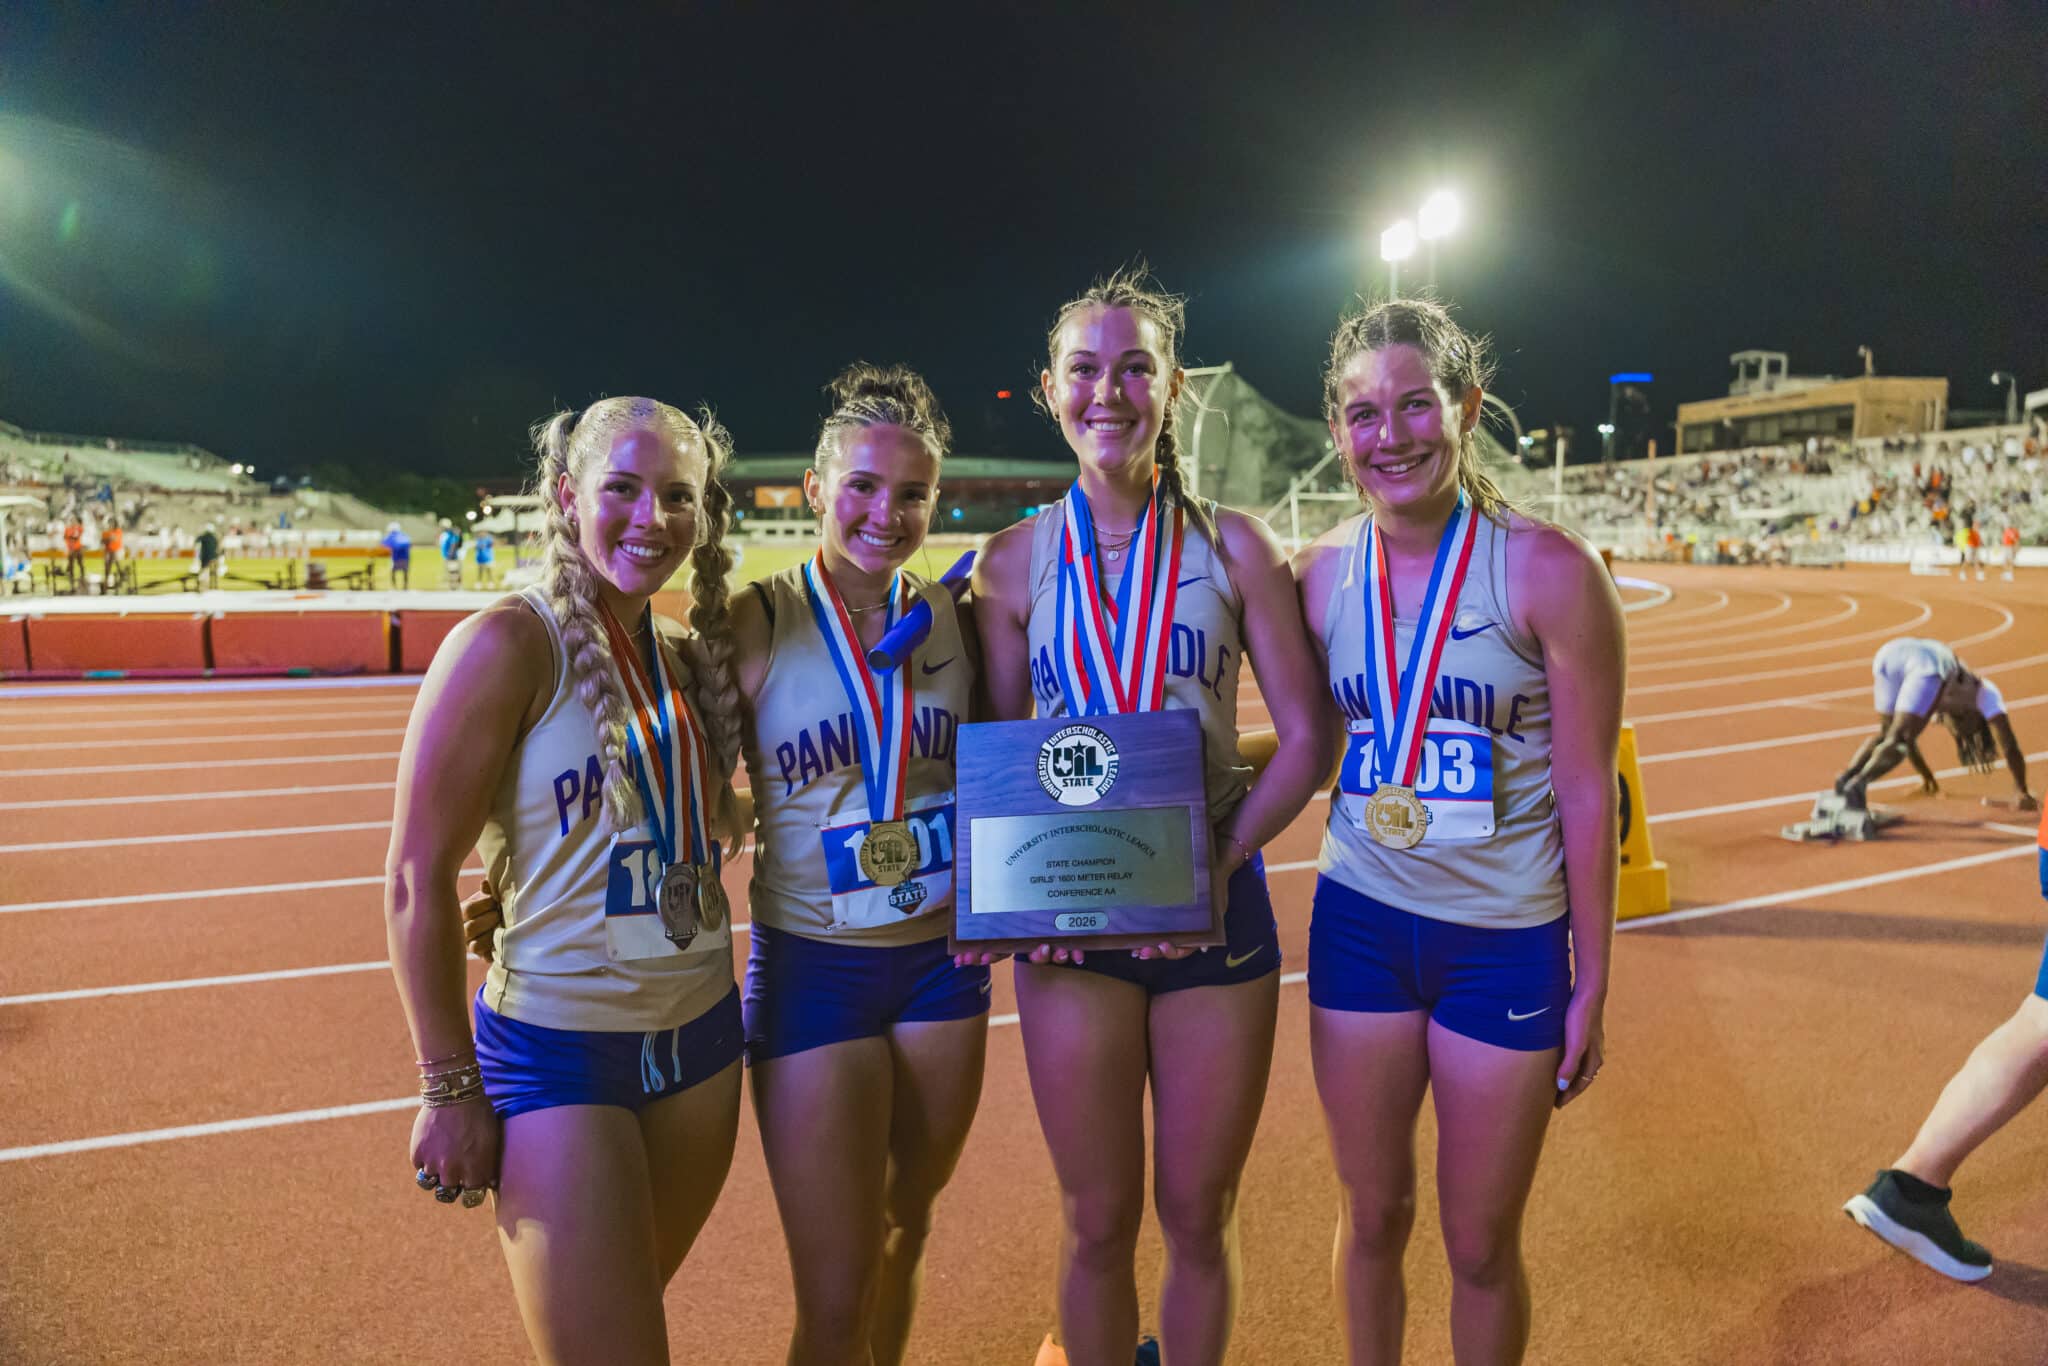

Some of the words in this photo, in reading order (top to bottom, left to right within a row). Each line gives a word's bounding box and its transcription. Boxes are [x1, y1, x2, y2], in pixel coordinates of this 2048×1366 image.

[1048, 725, 1116, 756] INTERSCHOLASTIC
[1053, 741, 1103, 777] UIL
[1038, 751, 1061, 799] UNIVERSITY
[1062, 777, 1094, 787] STATE
[1098, 761, 1118, 795] LEAGUE
[843, 813, 953, 882] 101
[1005, 832, 1049, 867] UNIVERSITY
[1049, 824, 1126, 839] INTERSCHOLASTIC
[1126, 834, 1158, 859] LEAGUE
[1046, 860, 1070, 868] STATE
[1071, 858, 1116, 867] CHAMPION
[1058, 874, 1076, 883] 1600
[1077, 873, 1106, 882] METER
[1107, 872, 1133, 880] RELAY
[889, 888, 927, 905] STATE
[1047, 889, 1103, 898] CONFERENCE
[1068, 916, 1097, 928] 2026
